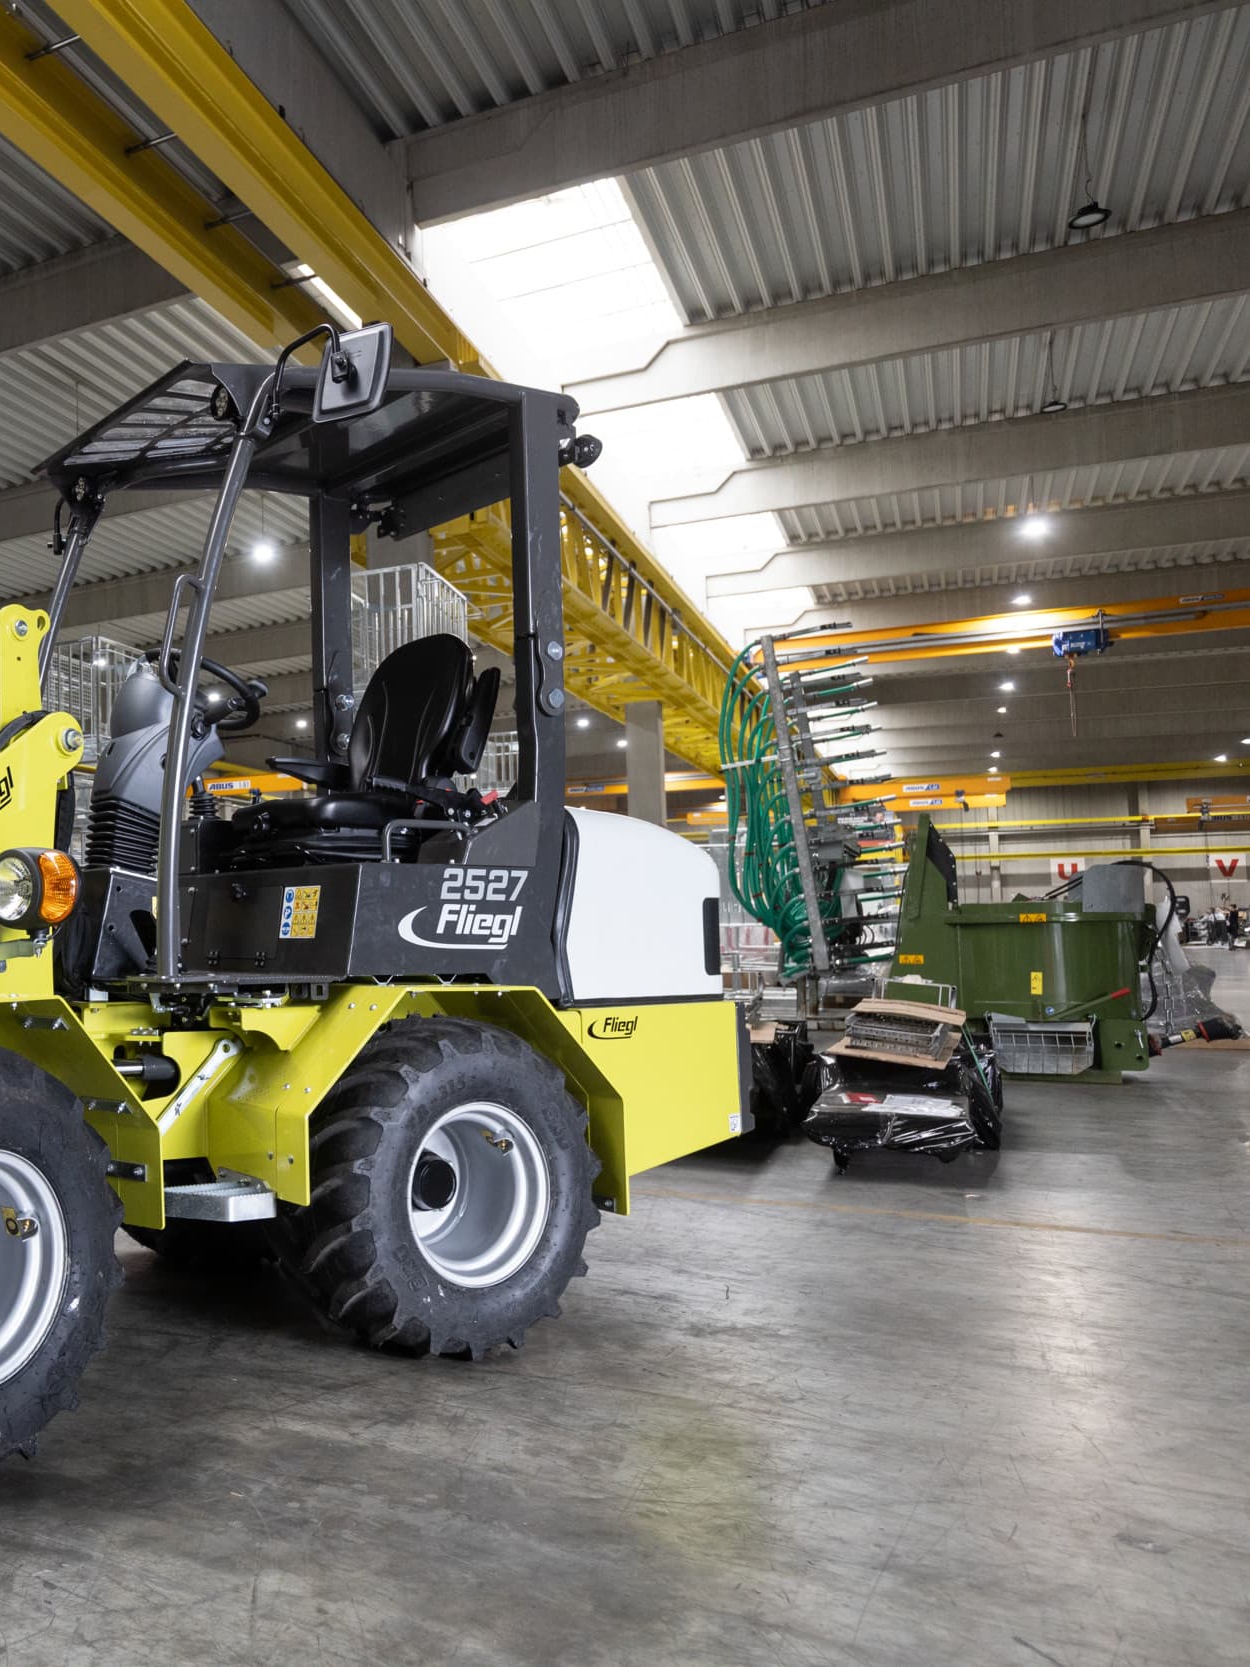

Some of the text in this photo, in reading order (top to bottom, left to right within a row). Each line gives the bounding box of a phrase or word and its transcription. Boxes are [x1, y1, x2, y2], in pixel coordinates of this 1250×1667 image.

[1058, 863, 1079, 880] U
[1215, 859, 1239, 878] V
[440, 868, 529, 901] 2527
[436, 904, 523, 943] Fliegl
[603, 1016, 639, 1035] Fliegl
